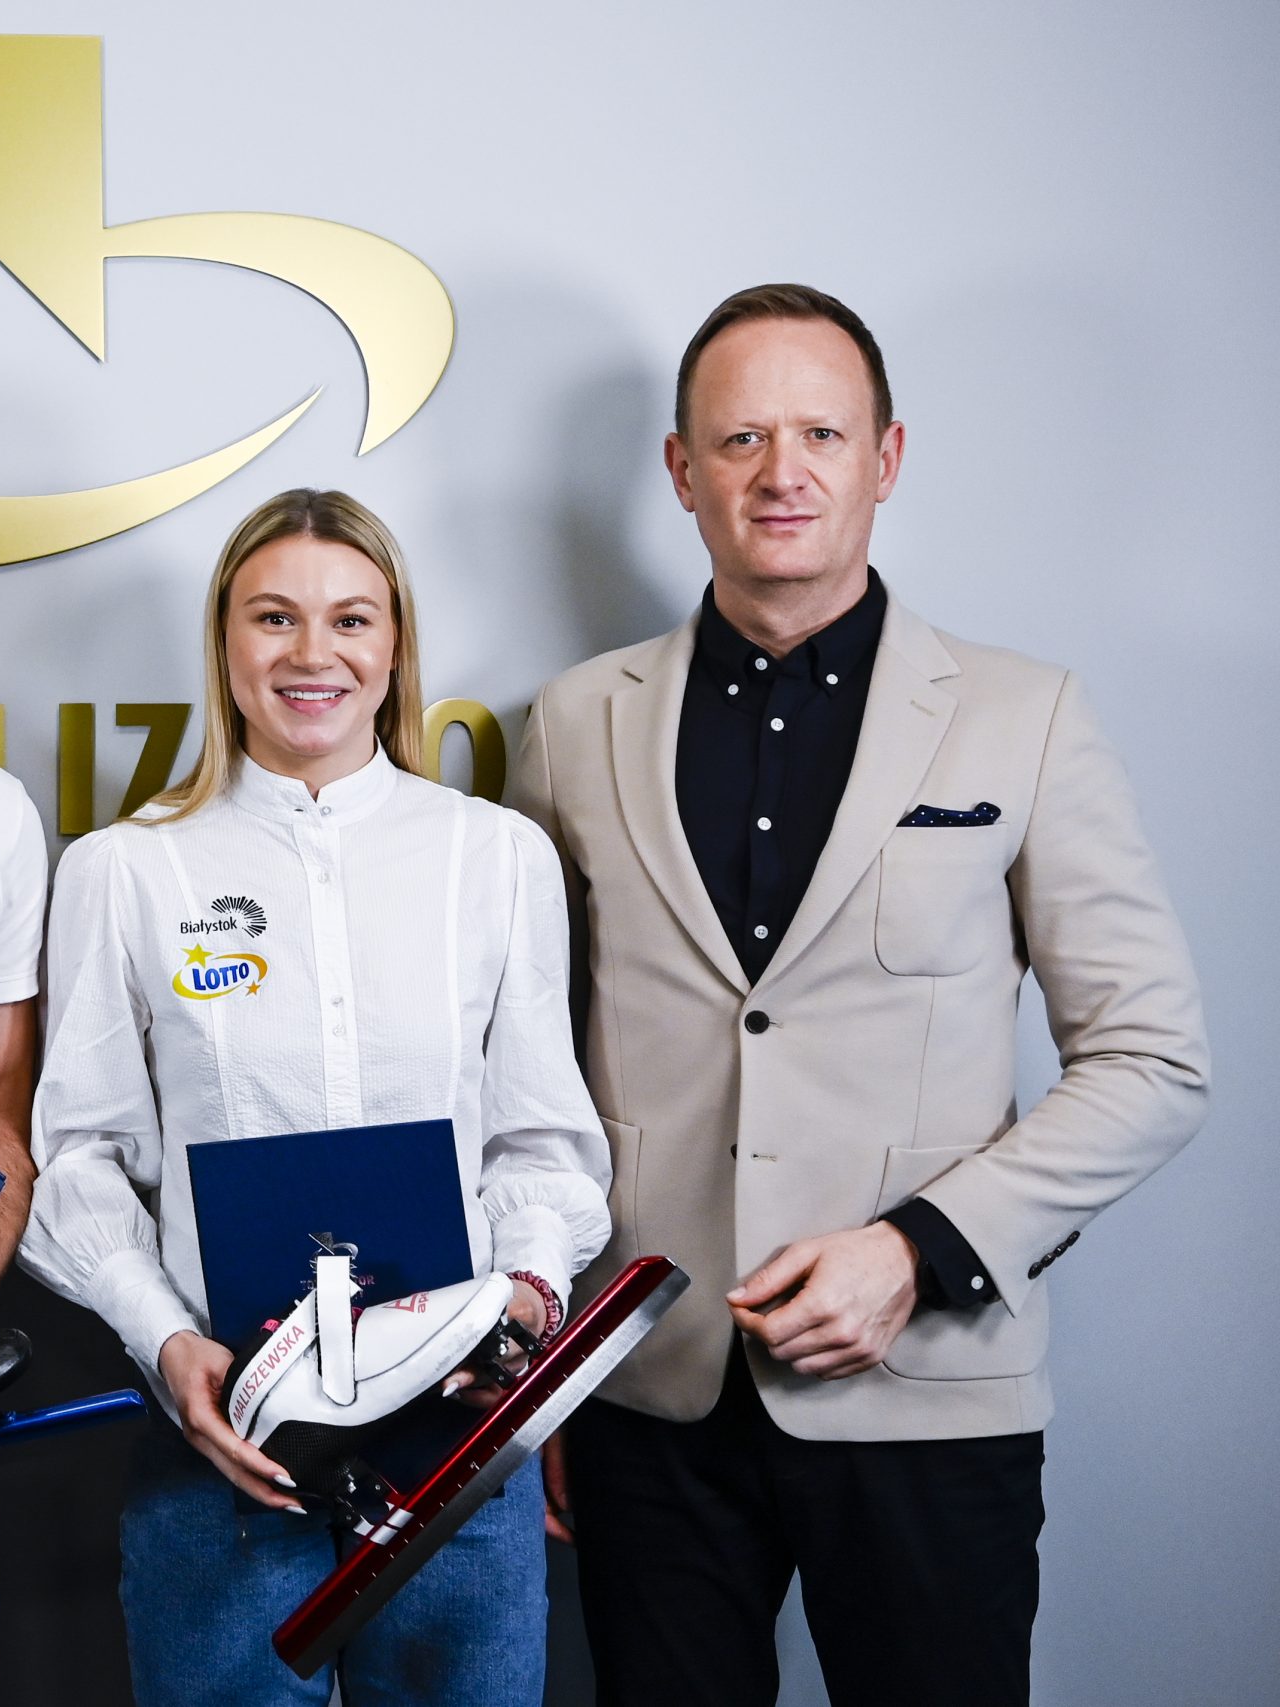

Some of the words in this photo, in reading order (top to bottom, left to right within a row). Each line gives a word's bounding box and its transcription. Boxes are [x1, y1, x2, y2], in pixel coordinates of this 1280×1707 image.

[180, 916, 238, 935] Białystok
[192, 962, 250, 991] LOTTO
[233, 1325, 305, 1425] MALISZEWSKA
